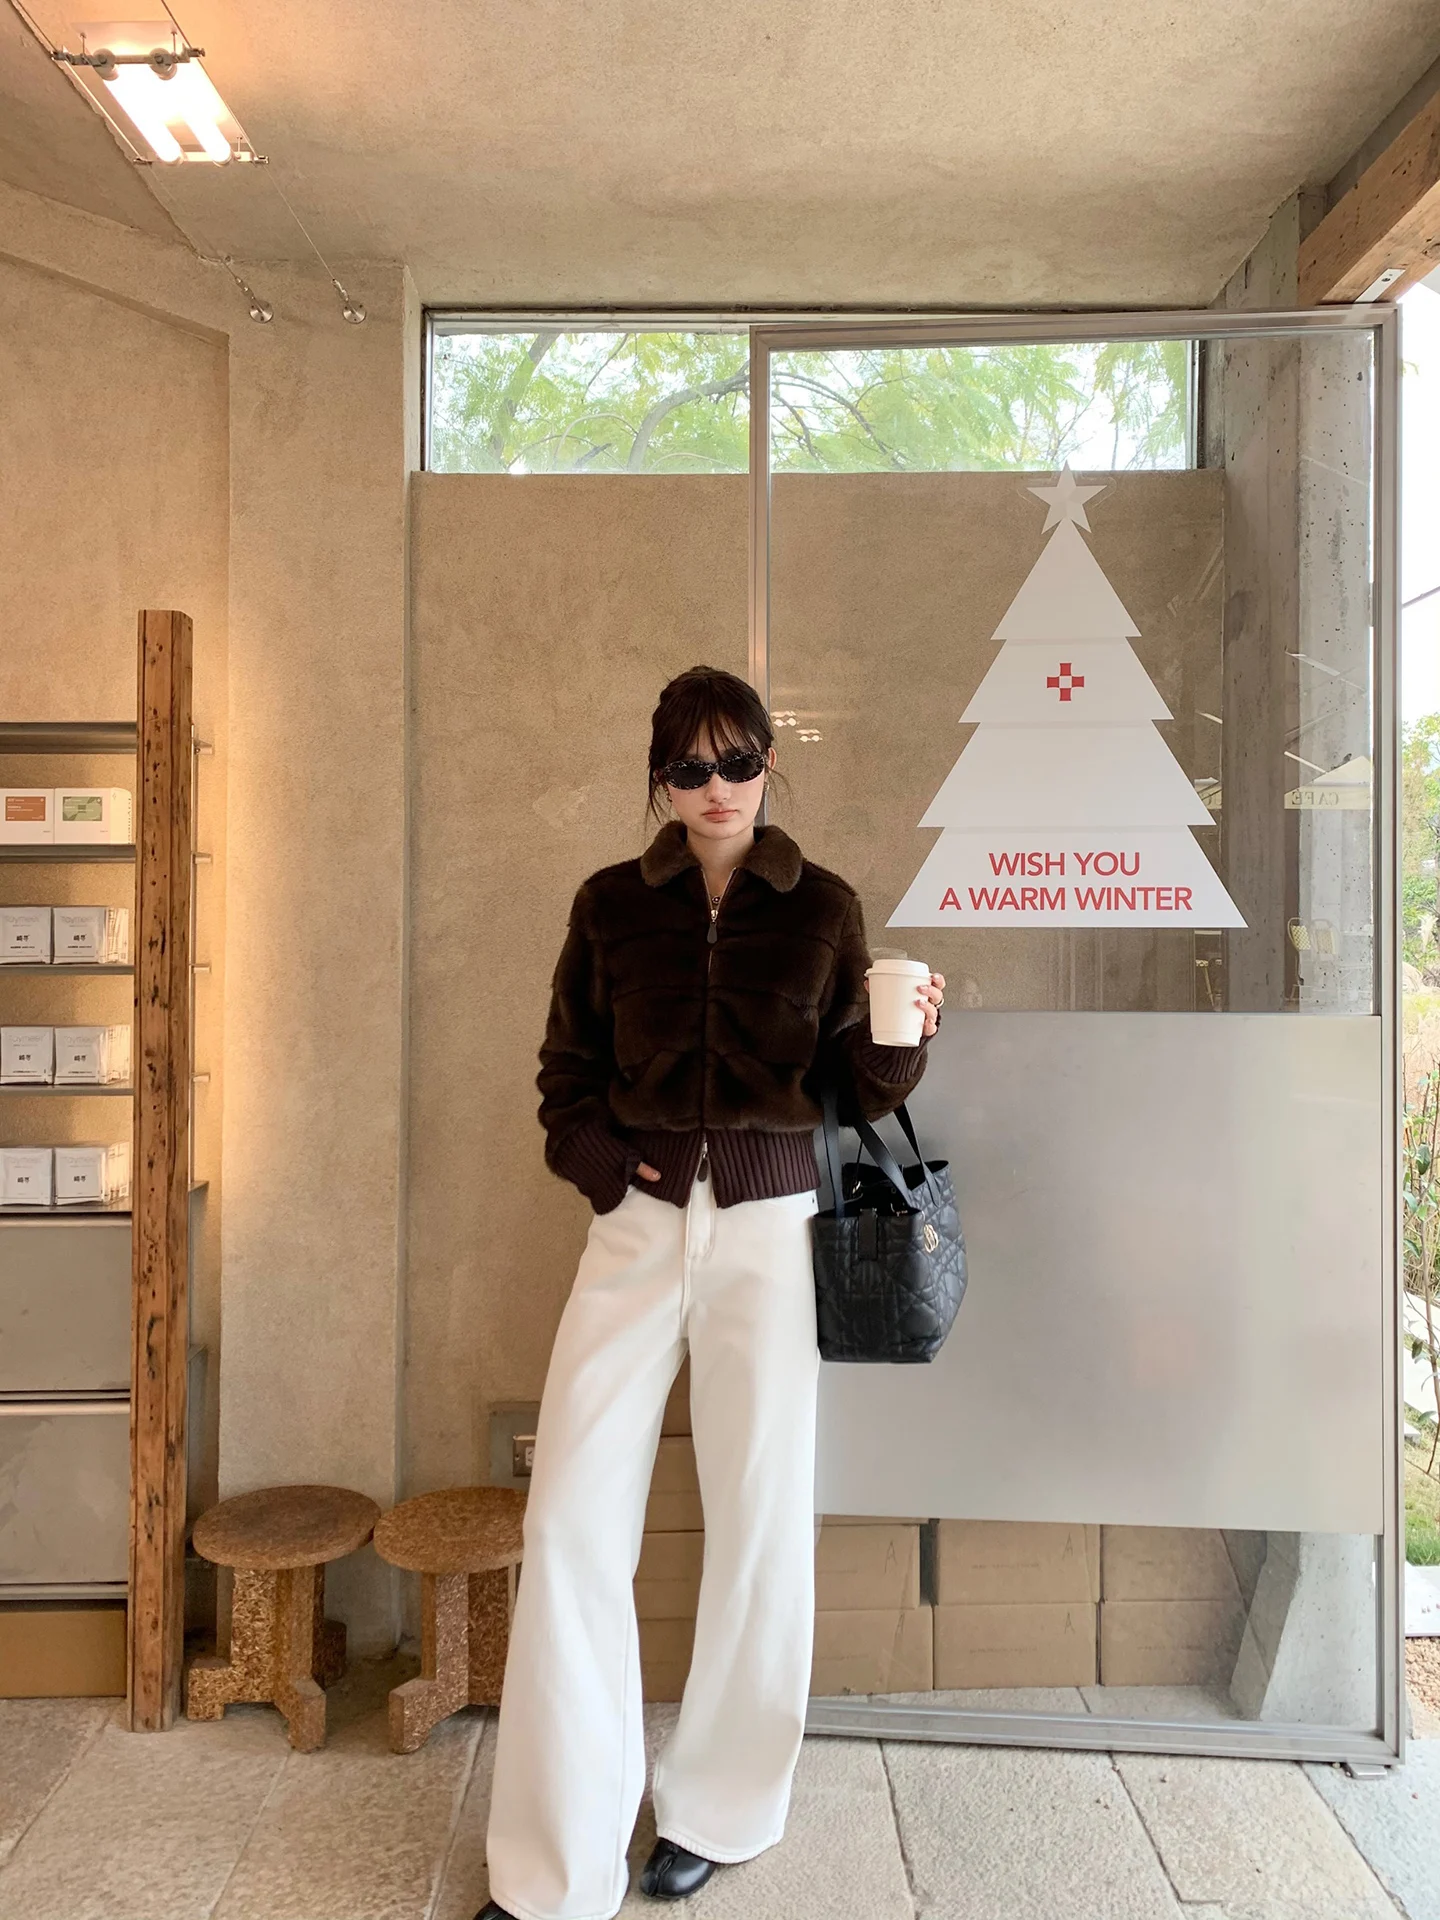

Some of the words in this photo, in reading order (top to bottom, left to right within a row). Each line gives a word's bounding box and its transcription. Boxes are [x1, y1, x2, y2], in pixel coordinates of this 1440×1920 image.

[988, 852, 1065, 876] WISH
[1073, 852, 1140, 876] YOU
[939, 887, 962, 911] A
[968, 887, 1066, 911] WARM
[1074, 887, 1193, 911] WINTER
